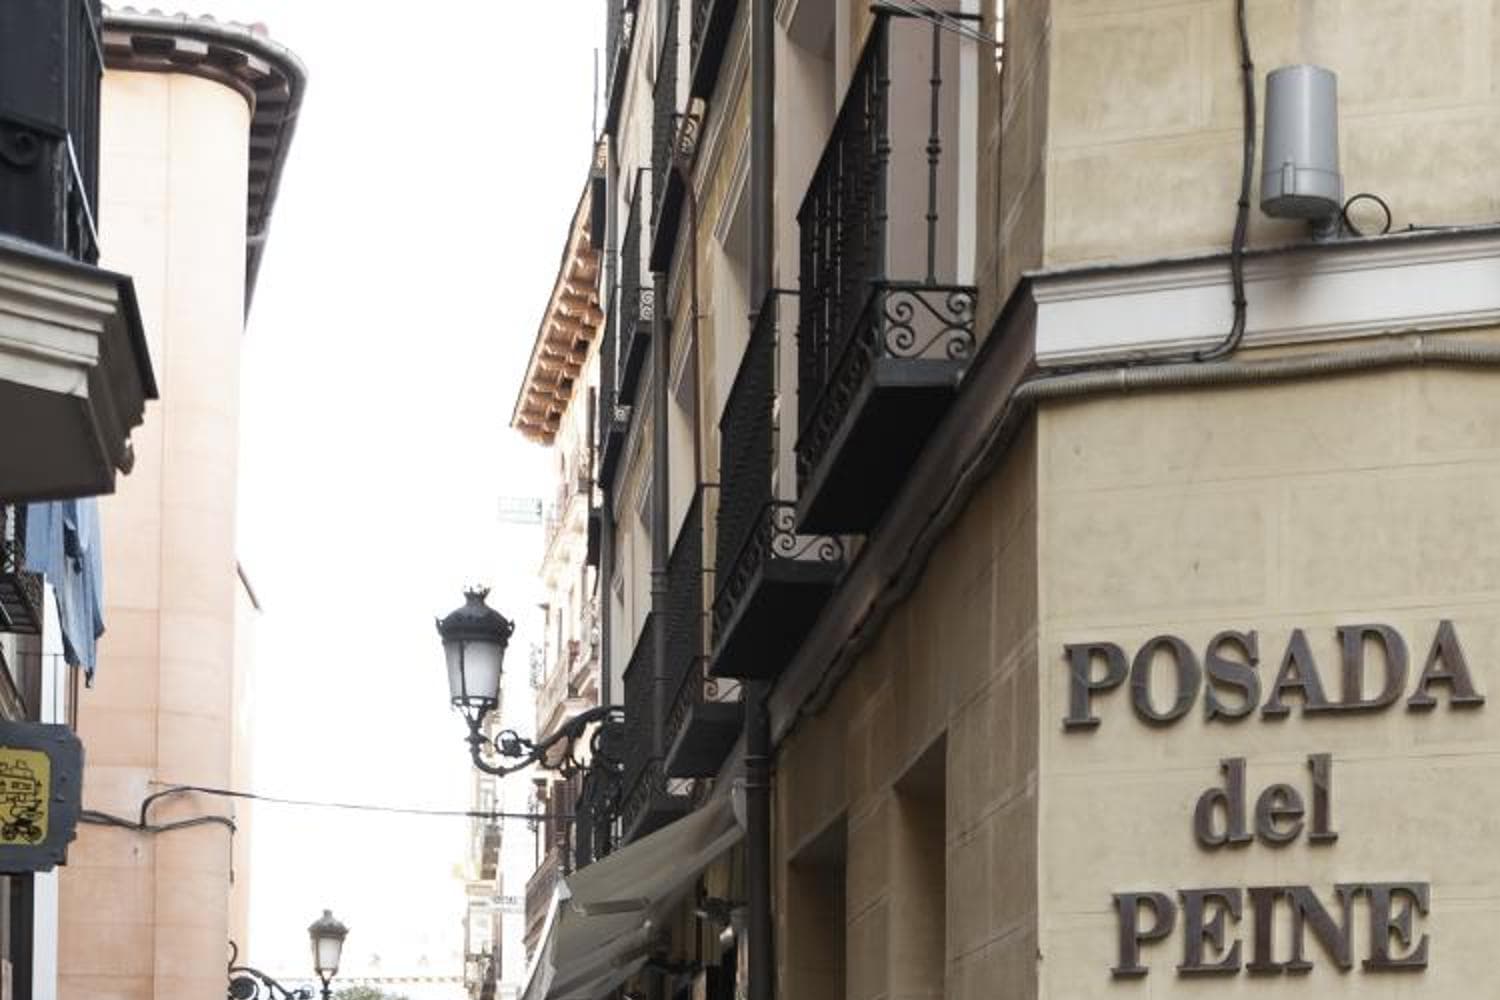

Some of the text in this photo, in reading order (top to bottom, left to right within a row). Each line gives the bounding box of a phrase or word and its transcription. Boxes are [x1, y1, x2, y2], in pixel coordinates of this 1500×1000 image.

[1062, 619, 1485, 732] POSADA
[1194, 753, 1338, 849] del
[1110, 881, 1430, 979] PEINE
